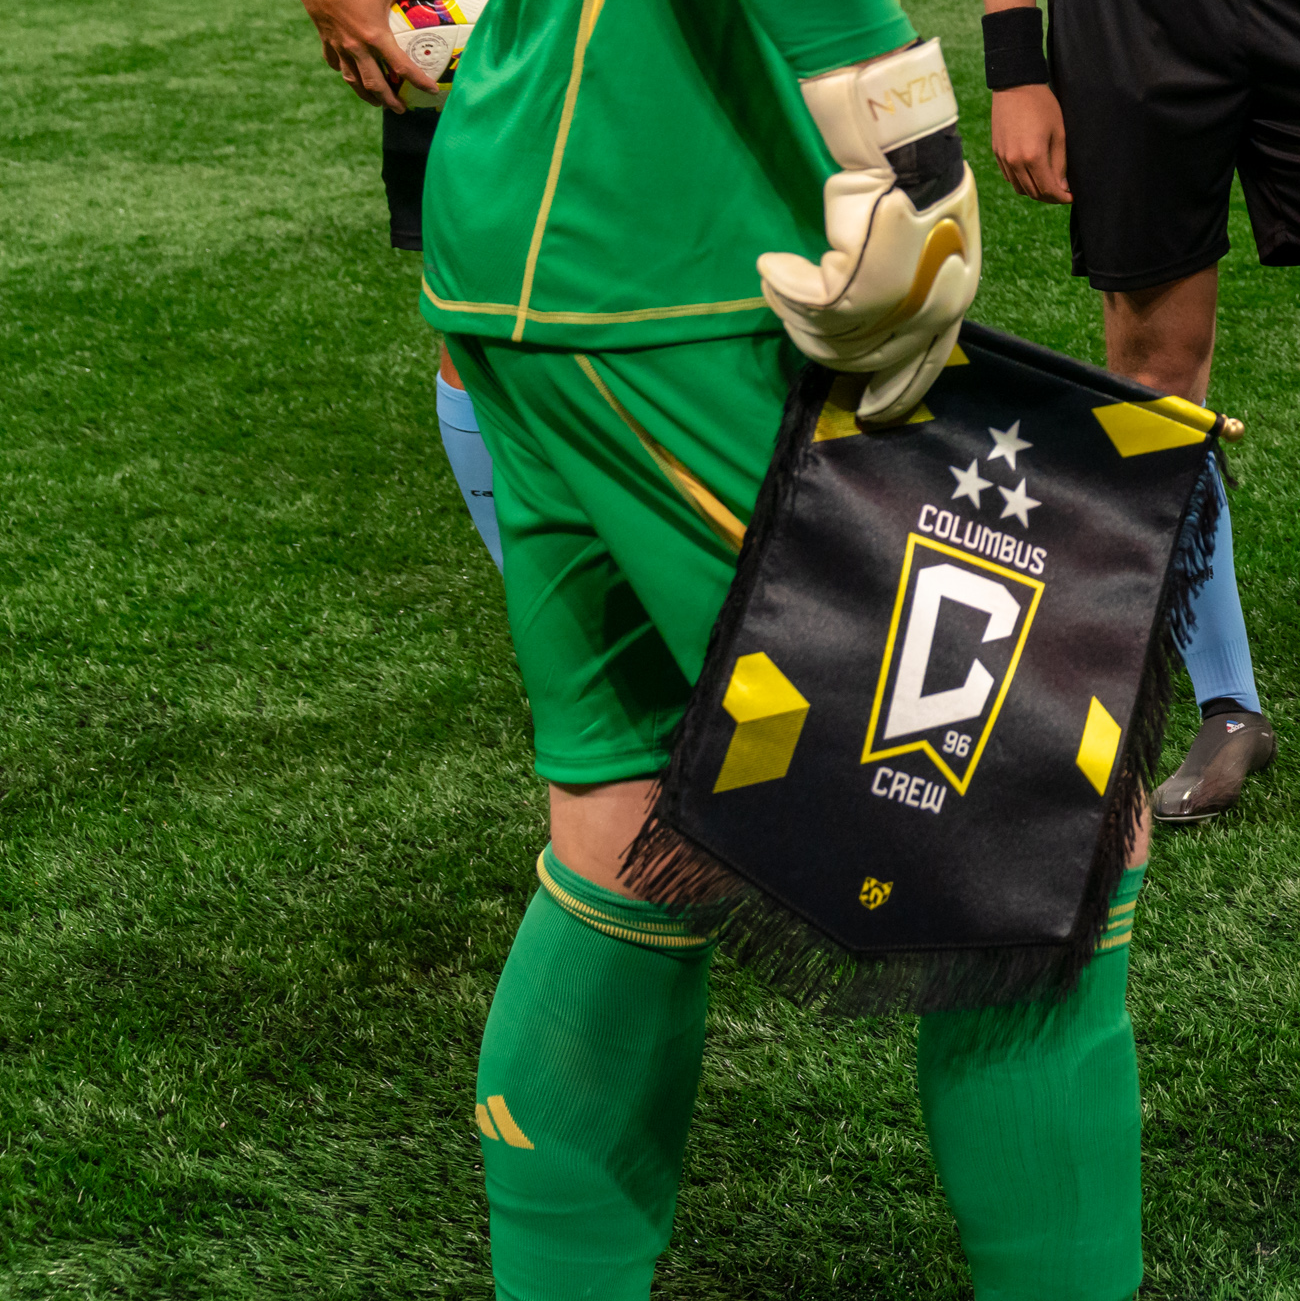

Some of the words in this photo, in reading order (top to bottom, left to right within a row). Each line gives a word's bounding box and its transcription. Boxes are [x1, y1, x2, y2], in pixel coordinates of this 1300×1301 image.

[918, 504, 1047, 575] COLUMBUS
[883, 563, 1021, 740] C
[942, 730, 972, 758] 96
[871, 766, 947, 815] CREW
